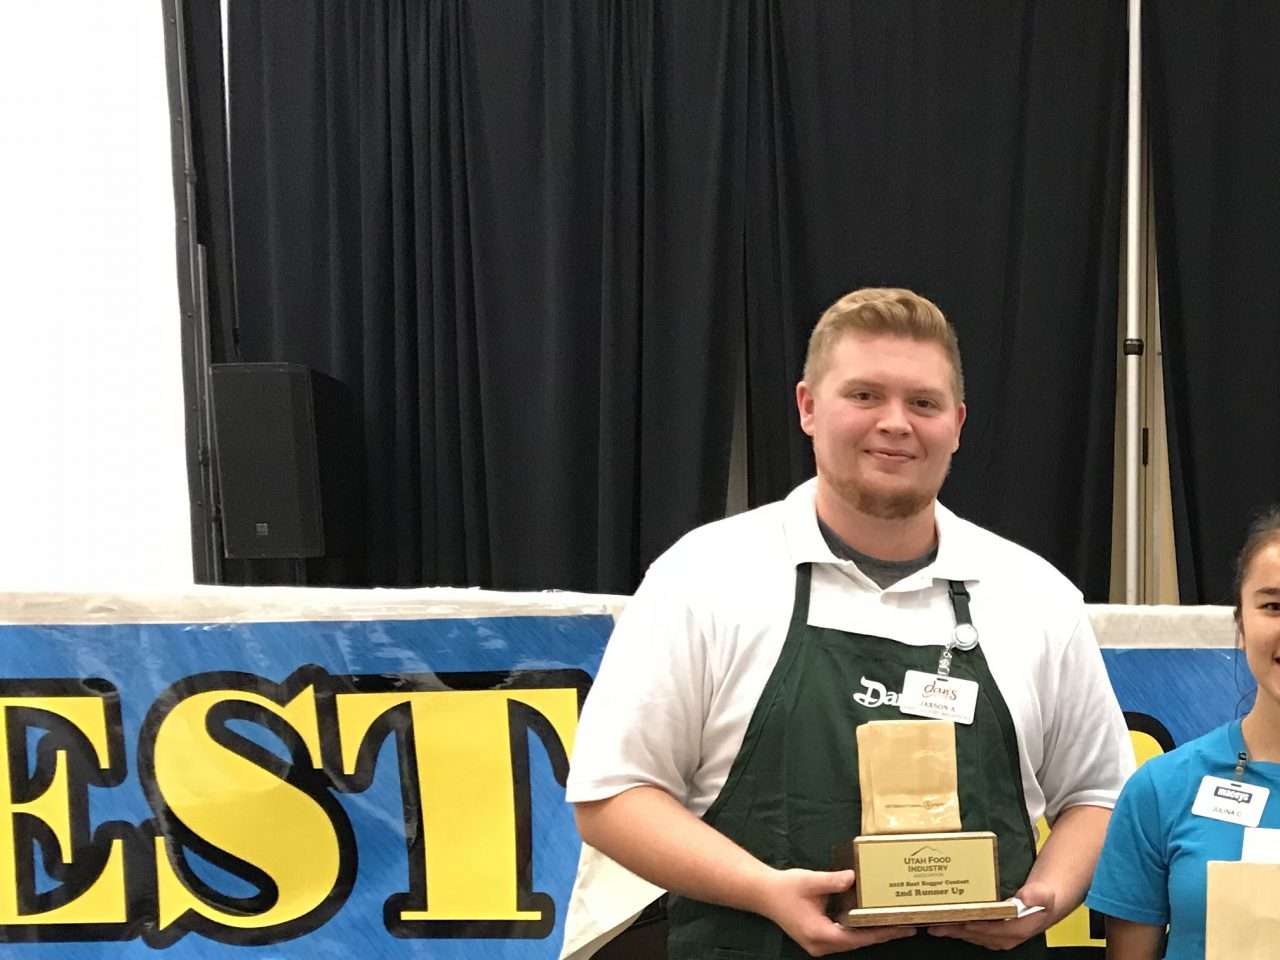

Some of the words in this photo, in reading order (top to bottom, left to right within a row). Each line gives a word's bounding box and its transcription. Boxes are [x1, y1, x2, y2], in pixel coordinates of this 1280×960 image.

[853, 676, 903, 708] Da
[928, 856, 951, 864] FOOD
[908, 864, 948, 872] INDUSTRY
[915, 888, 949, 896] Runner
[951, 887, 964, 895] Up
